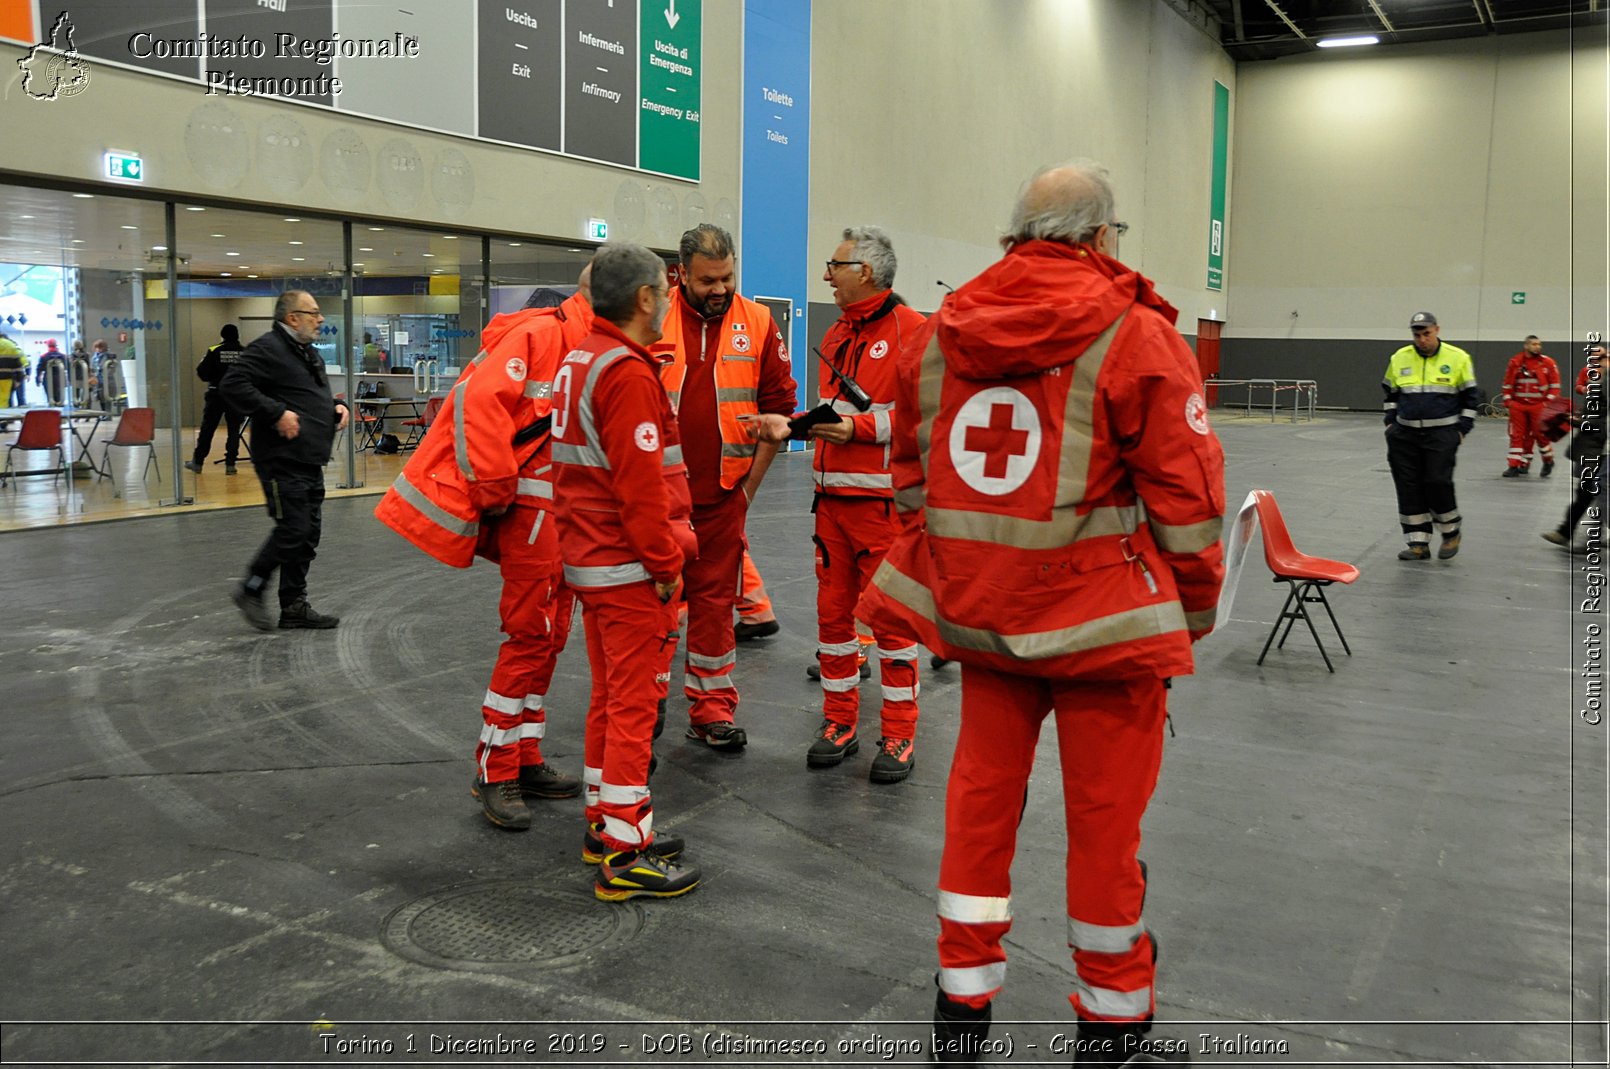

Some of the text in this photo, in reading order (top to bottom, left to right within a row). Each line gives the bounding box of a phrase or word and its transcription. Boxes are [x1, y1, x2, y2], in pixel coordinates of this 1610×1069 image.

[505, 7, 538, 29] Uscita
[578, 30, 625, 55] Infermeria
[654, 39, 688, 60] Uscita di
[512, 63, 531, 79] Exit
[649, 53, 693, 76] Emergenza
[582, 82, 621, 104] Infirmary
[762, 87, 793, 107] Toilette
[641, 98, 700, 122] Emergency Exit
[766, 129, 788, 145] Toilets
